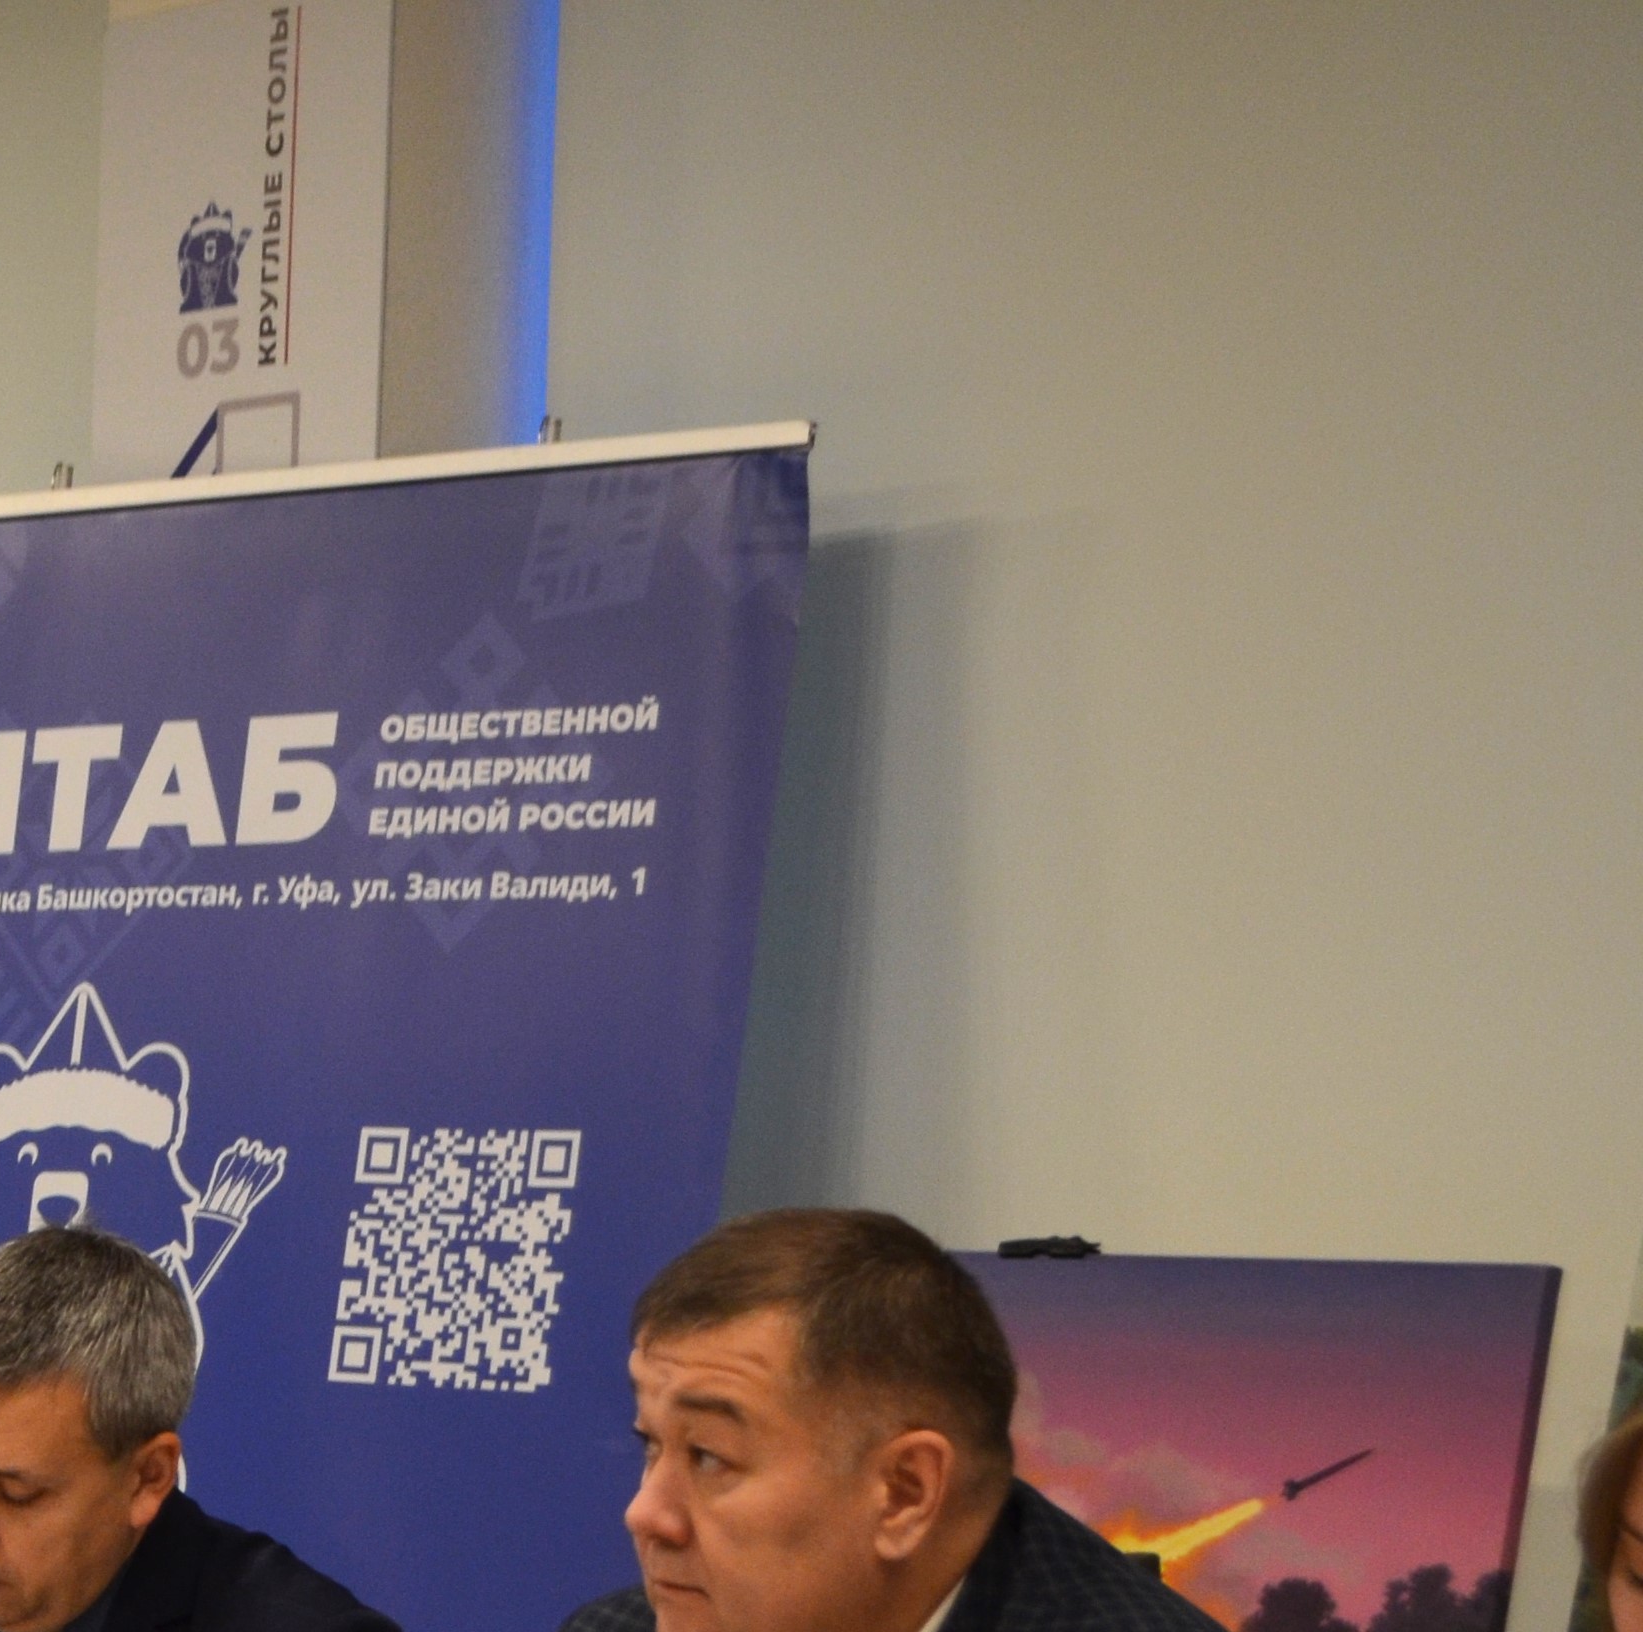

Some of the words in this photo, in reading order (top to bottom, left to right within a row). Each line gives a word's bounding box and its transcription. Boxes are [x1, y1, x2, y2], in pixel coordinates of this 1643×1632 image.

[264, 6, 290, 158] СТОЛЫ
[257, 171, 284, 367] КРУГЛЫЕ
[176, 317, 242, 379] 03
[380, 695, 660, 745] ОБЩЕСТВЕННОЙ
[373, 752, 593, 793] ПОДДЕРЖКИ
[367, 797, 511, 840] ЕДИНОЙ
[518, 798, 658, 833] РОССИИ
[35, 882, 244, 917] Башкортостан,
[252, 883, 270, 906] г.
[278, 873, 342, 911] Уфа,
[349, 876, 396, 909] ул.
[403, 872, 483, 901] Заки
[488, 870, 618, 903] Валиди,
[630, 867, 647, 896] 1
